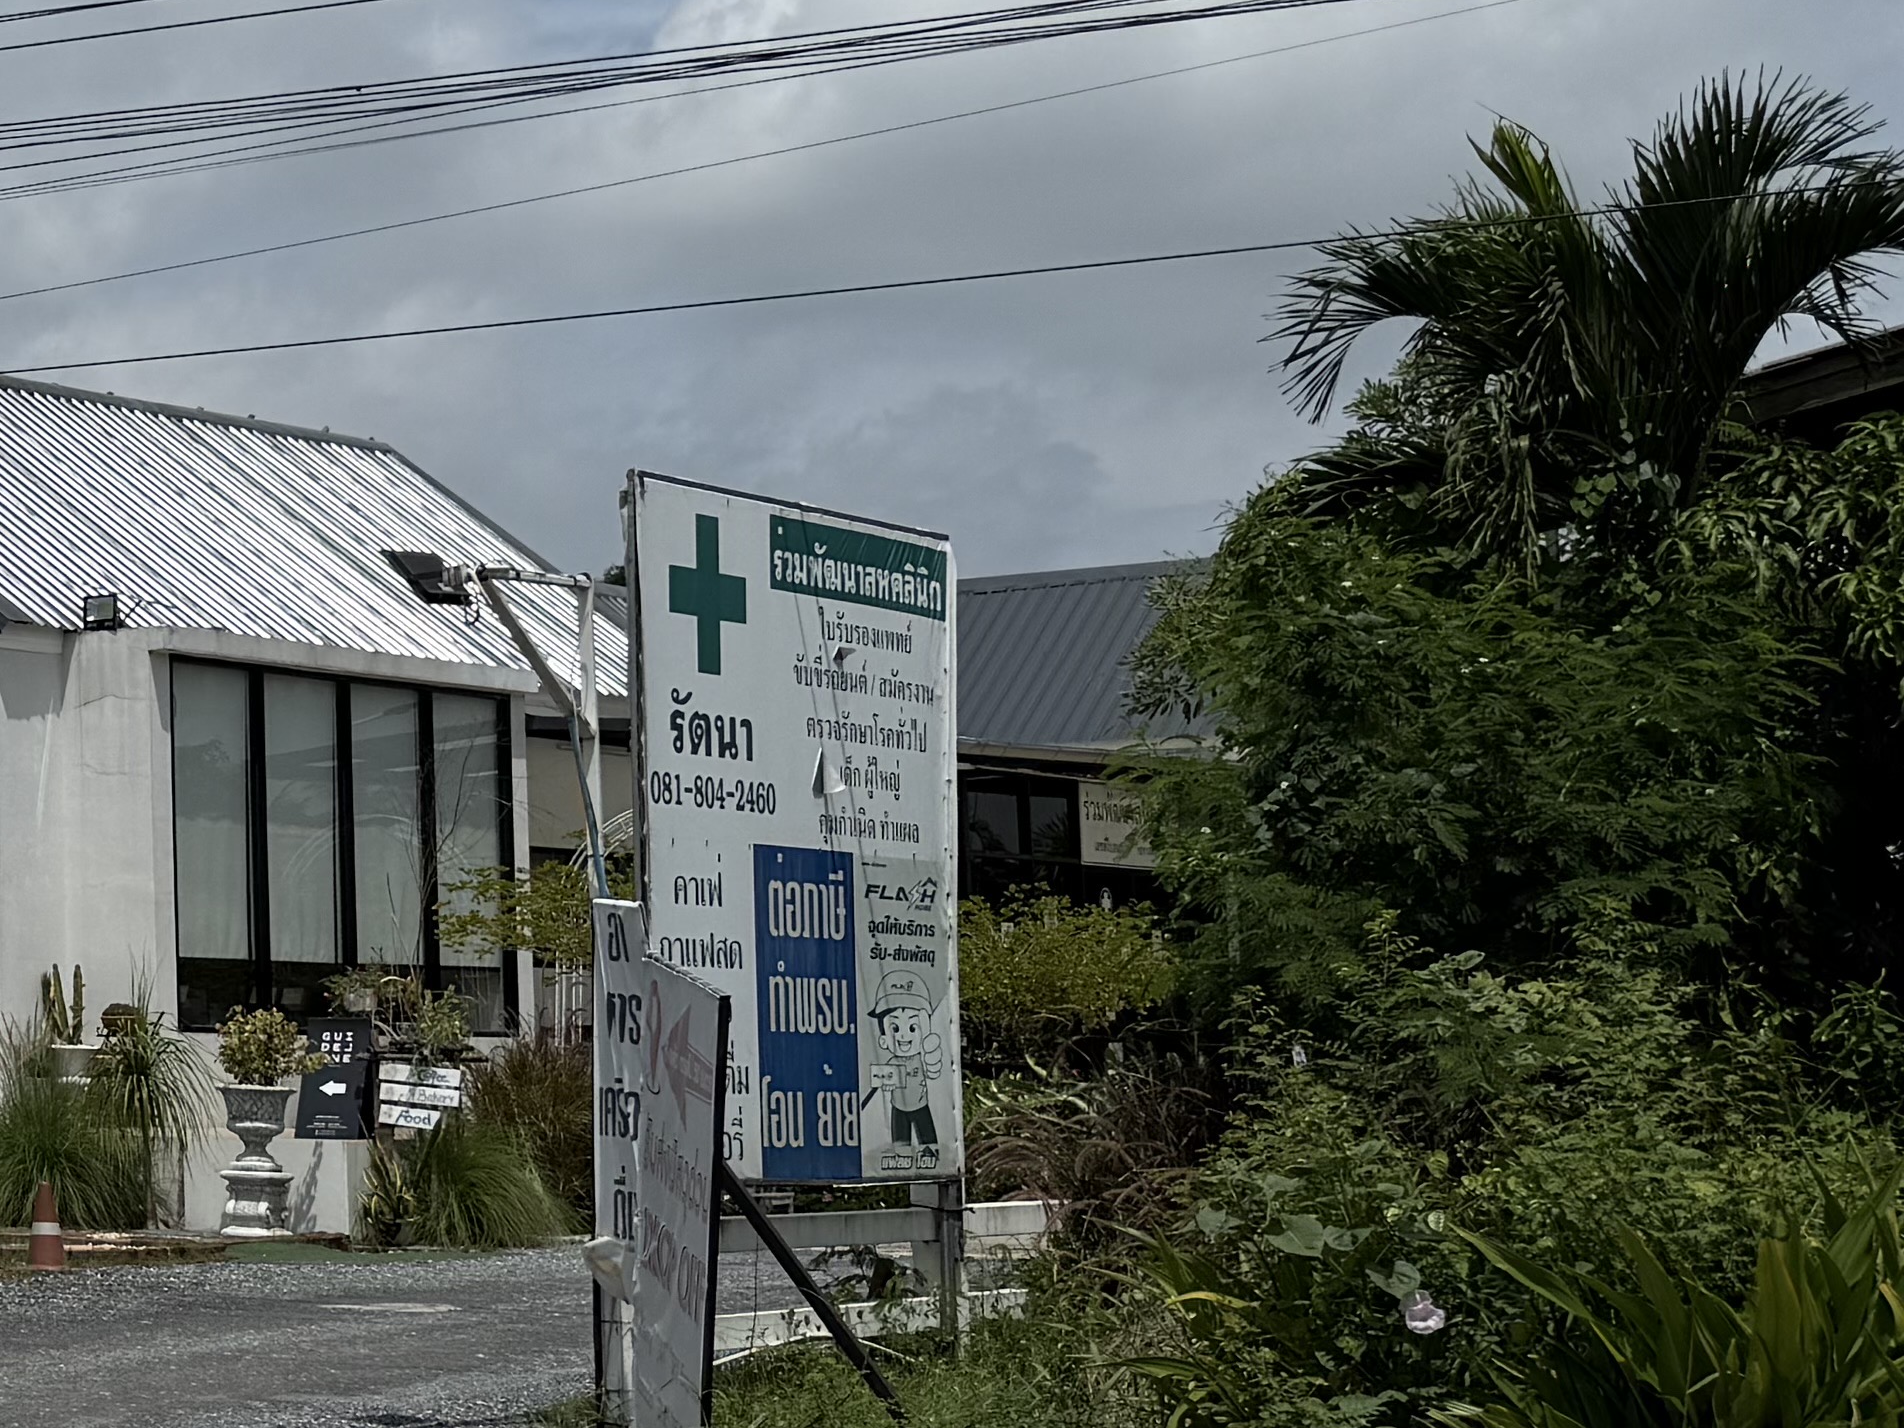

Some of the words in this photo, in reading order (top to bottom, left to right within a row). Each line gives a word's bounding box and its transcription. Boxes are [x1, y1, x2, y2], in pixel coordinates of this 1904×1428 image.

[773, 526, 942, 612] ร่วมพัฒนาสหคลินิก
[818, 606, 913, 655] ใบรับรองแพทย์
[879, 668, 934, 706] สมัครงาน
[670, 687, 754, 762] รัตนา
[806, 707, 927, 753] ตรวจรักษาโรคทั่วไป
[650, 770, 777, 815] 081-804-2460
[880, 811, 920, 844] ทำแผล
[674, 853, 723, 907] คาเฟ่
[768, 852, 847, 941] ต่อภาษี
[395, 1110, 431, 1126] Food
[761, 1075, 804, 1148] โอน
[817, 1063, 859, 1147] ย้าย
